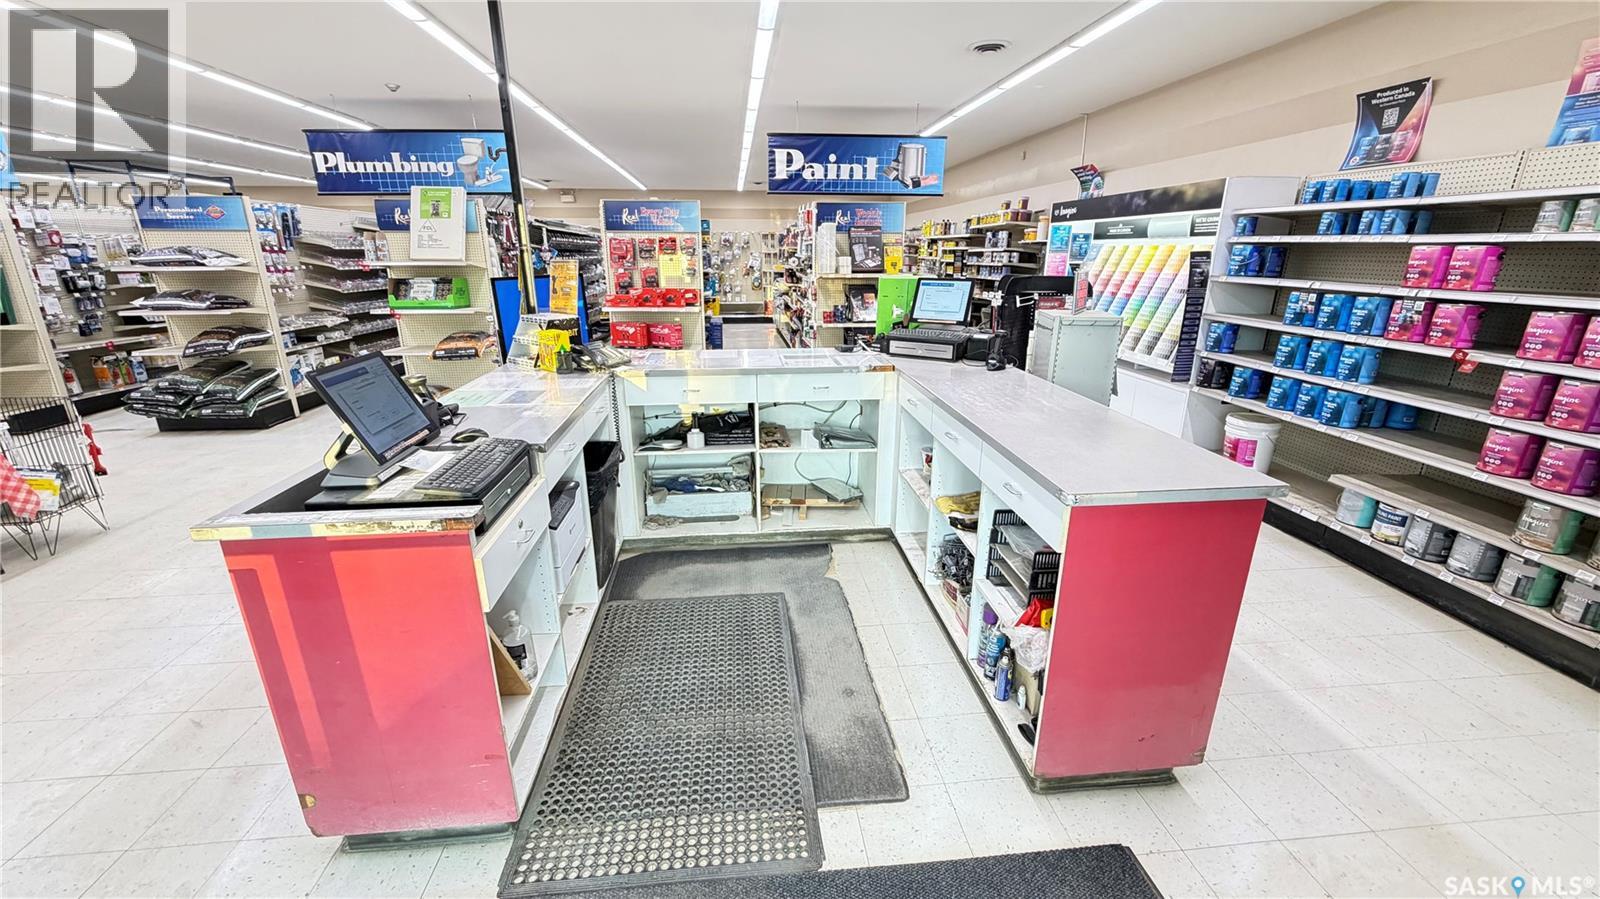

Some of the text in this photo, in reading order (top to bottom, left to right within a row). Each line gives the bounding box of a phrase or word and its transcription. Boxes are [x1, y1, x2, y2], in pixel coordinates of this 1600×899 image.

[1371, 95, 1394, 105] Western
[1394, 91, 1416, 100] Canada
[1376, 88, 1403, 98] Produced
[312, 151, 454, 177] Plumbing
[770, 148, 879, 180] Paint
[154, 205, 203, 213] Personalized
[640, 206, 680, 219] Every Day
[1060, 205, 1078, 219] Imagine
[622, 207, 640, 225] Real
[835, 209, 851, 225] Real
[1526, 327, 1554, 336] Imagine
[1498, 384, 1525, 394] Imagine
[1486, 440, 1512, 452] Imagine
[1388, 513, 1402, 521] PAINT
[1522, 513, 1552, 528] Imagine
